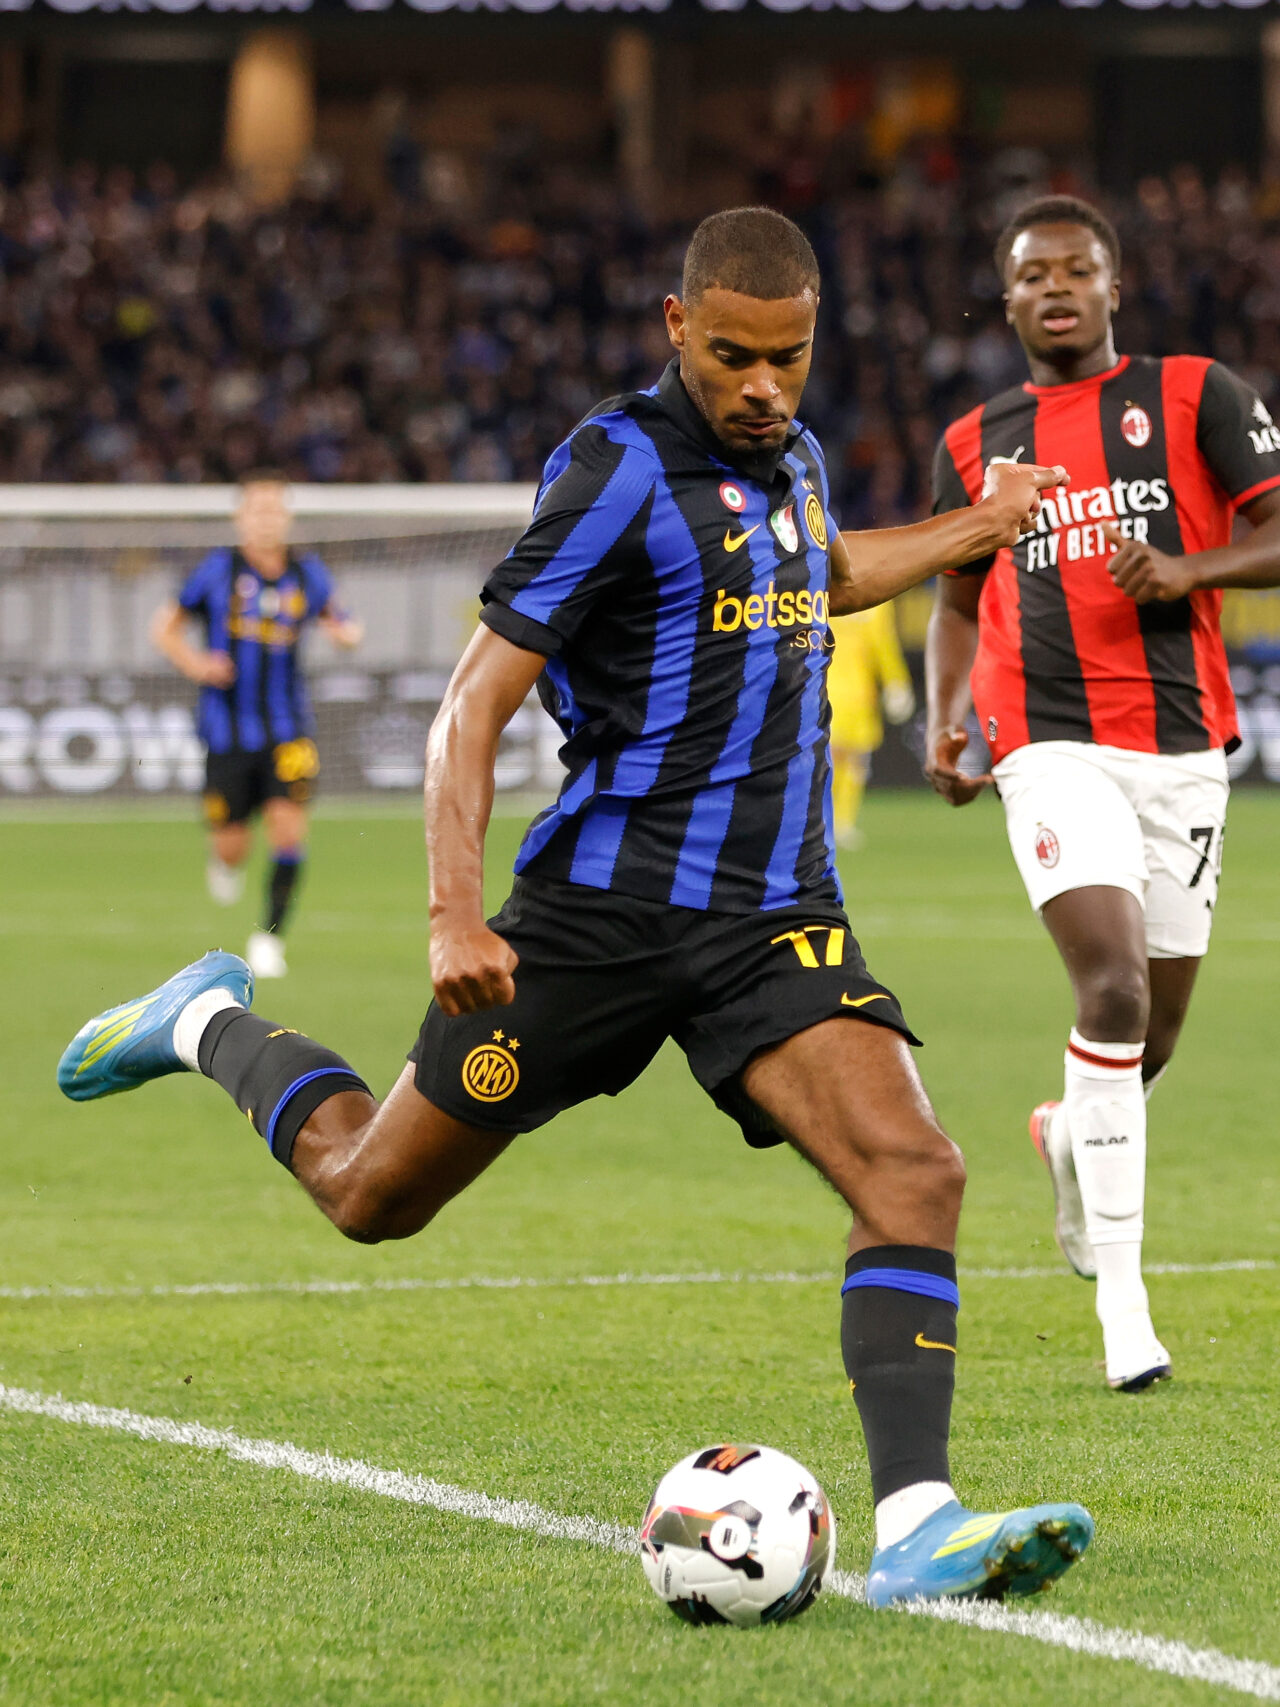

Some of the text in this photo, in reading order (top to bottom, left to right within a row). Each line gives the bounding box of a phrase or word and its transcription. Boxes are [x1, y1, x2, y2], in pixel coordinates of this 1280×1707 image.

[1016, 477, 1170, 544] mirates
[1027, 533, 1060, 573] FLY
[712, 581, 829, 632] betsso
[771, 926, 844, 968] 17
